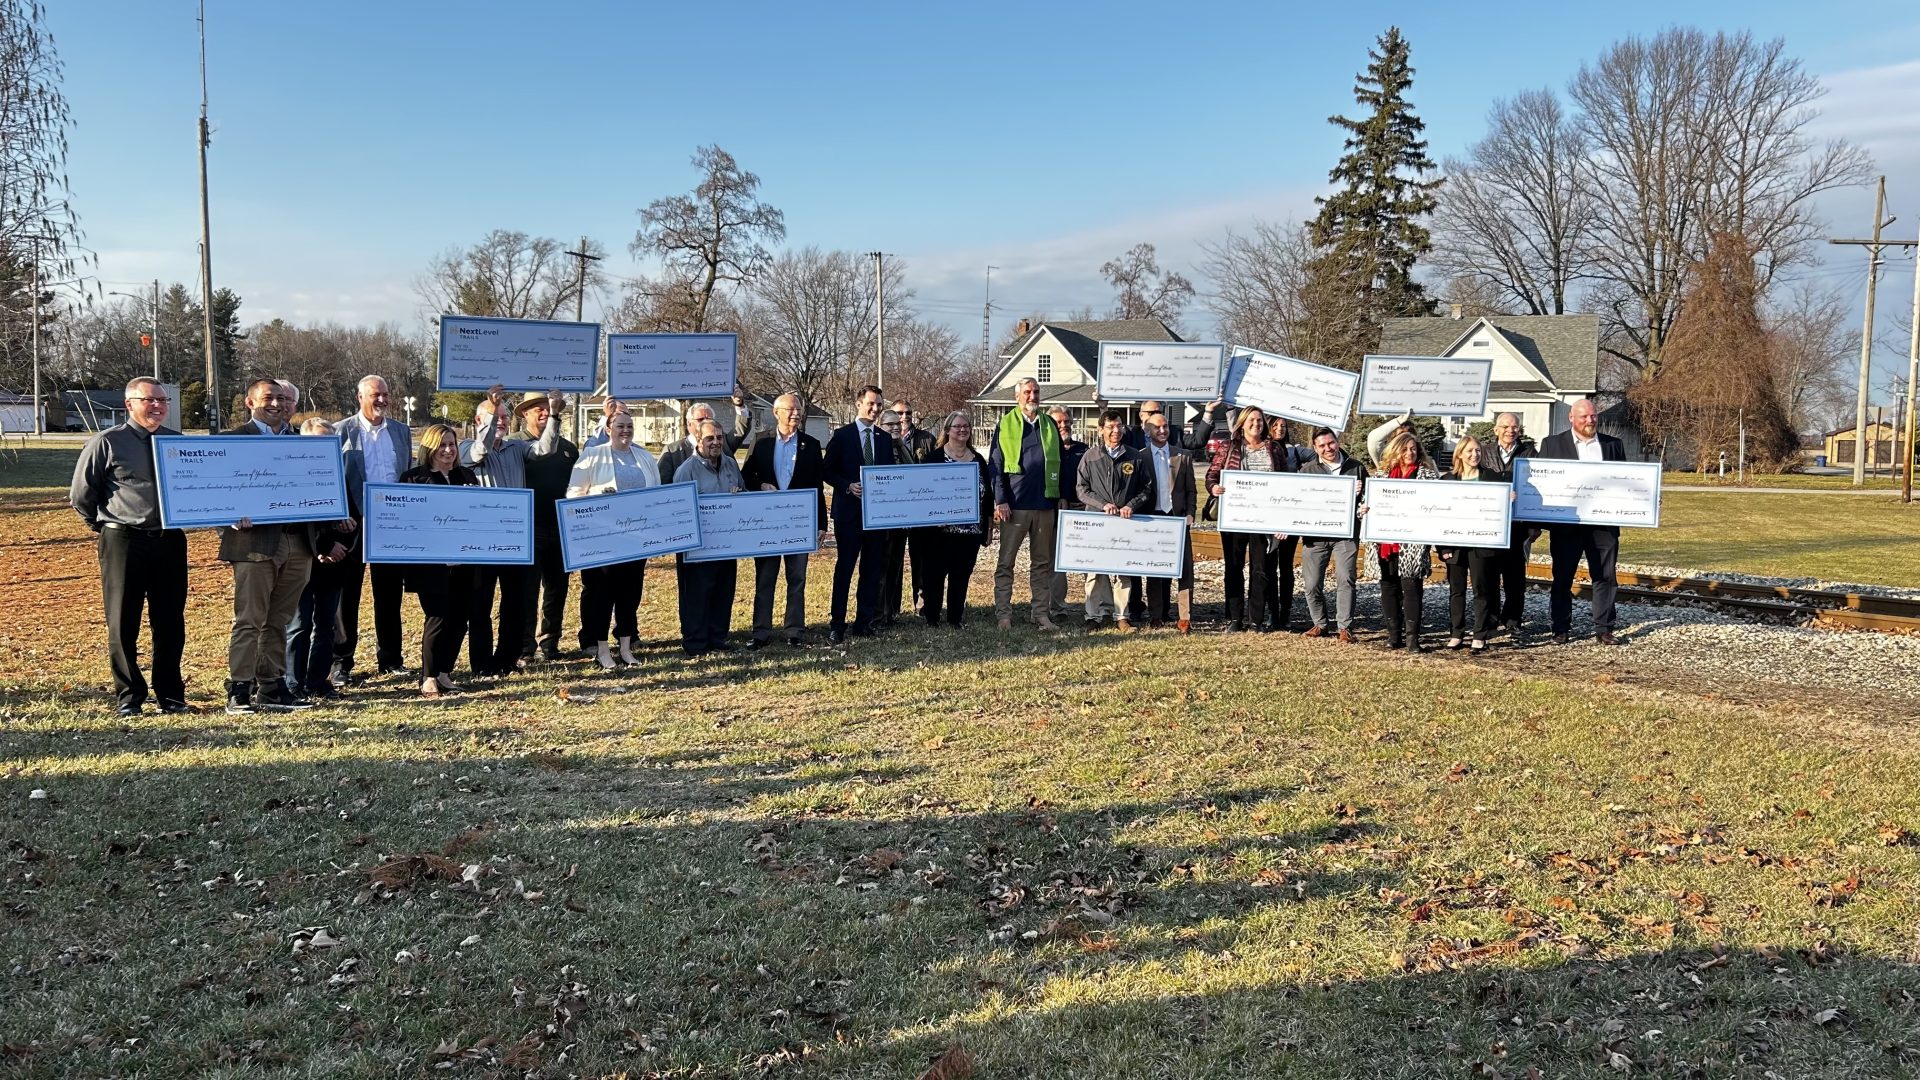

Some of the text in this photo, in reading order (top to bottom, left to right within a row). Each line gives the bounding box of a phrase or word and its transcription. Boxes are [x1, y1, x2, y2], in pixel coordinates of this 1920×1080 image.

[459, 327, 498, 336] NextLevel
[1246, 358, 1276, 368] NextLevel
[179, 449, 226, 457] NextLevel
[385, 495, 427, 503] NextLevel
[575, 504, 610, 514] NextLevel
